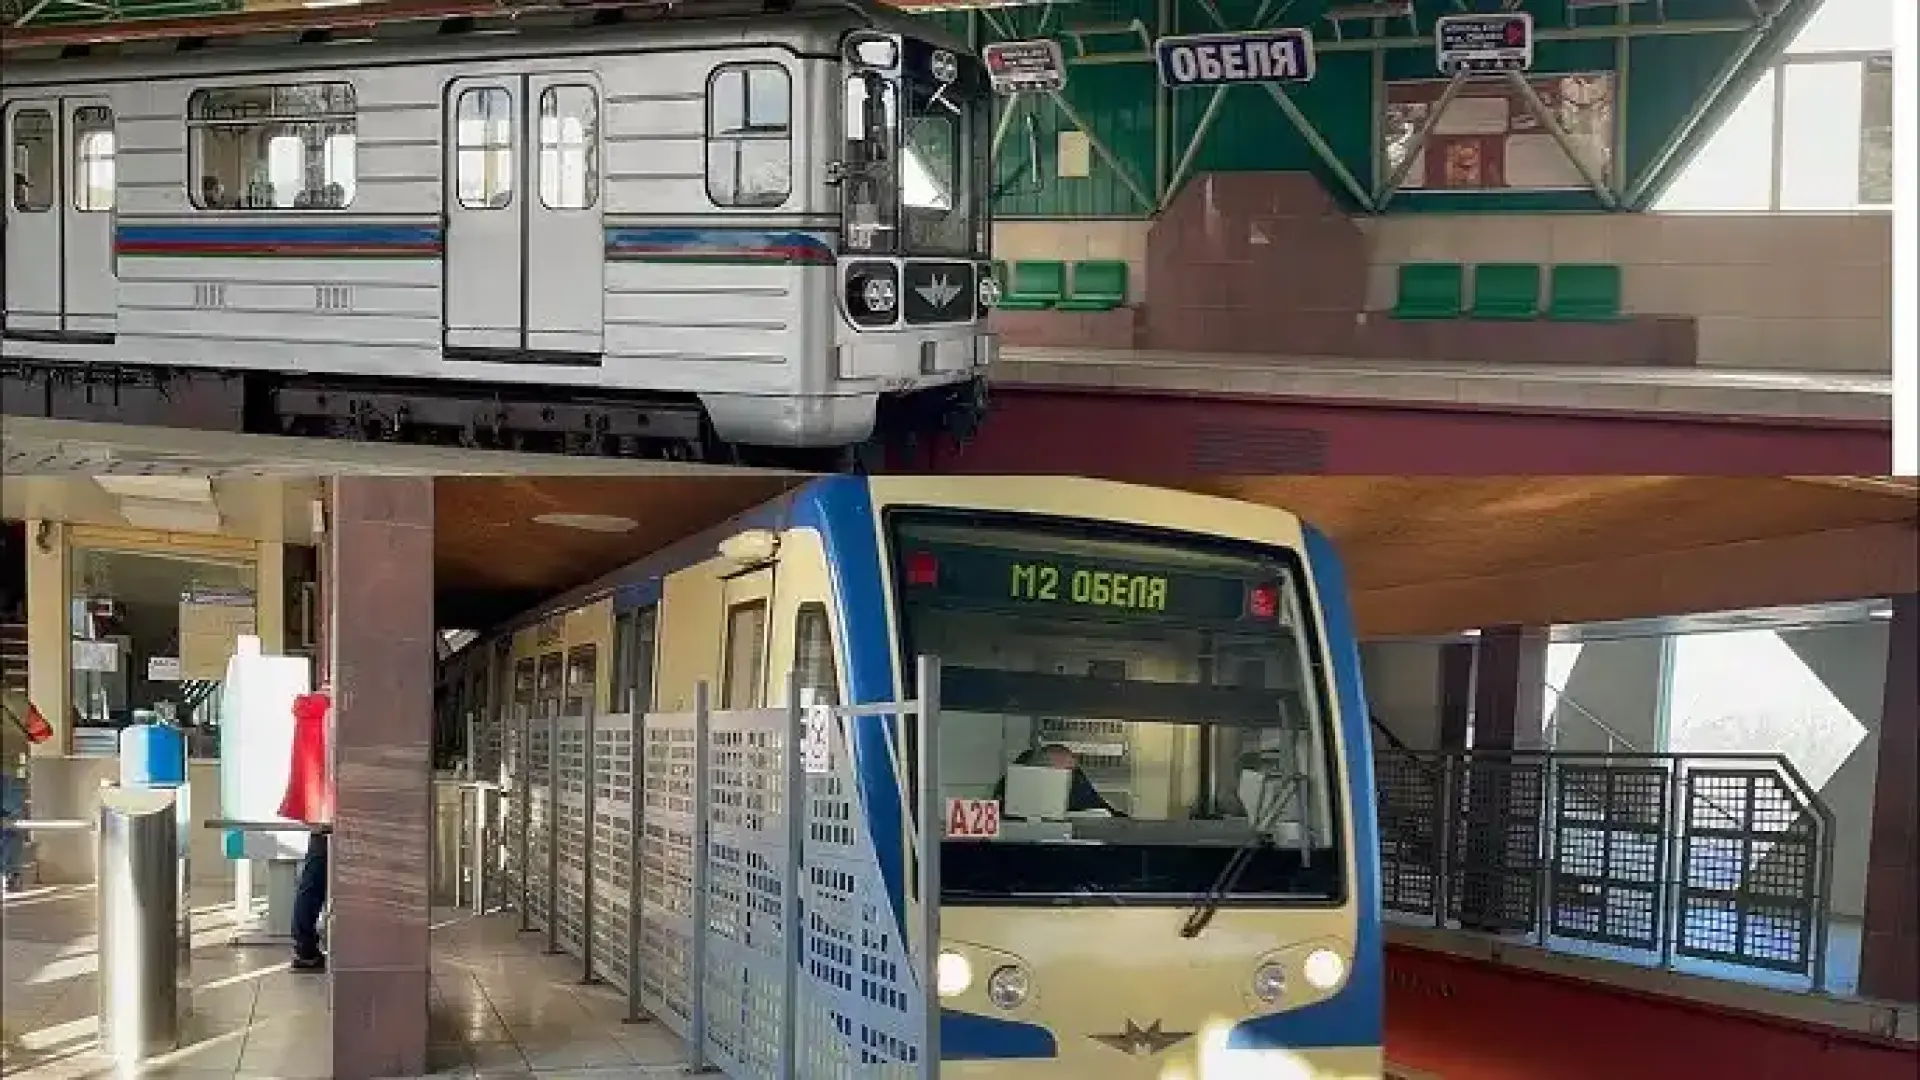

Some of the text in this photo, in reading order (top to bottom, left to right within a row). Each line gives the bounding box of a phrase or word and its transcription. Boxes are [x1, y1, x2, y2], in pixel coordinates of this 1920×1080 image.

[1171, 41, 1298, 82] ОБЕЛЯ
[1010, 563, 1167, 611] М2 ОБЕЛЯ
